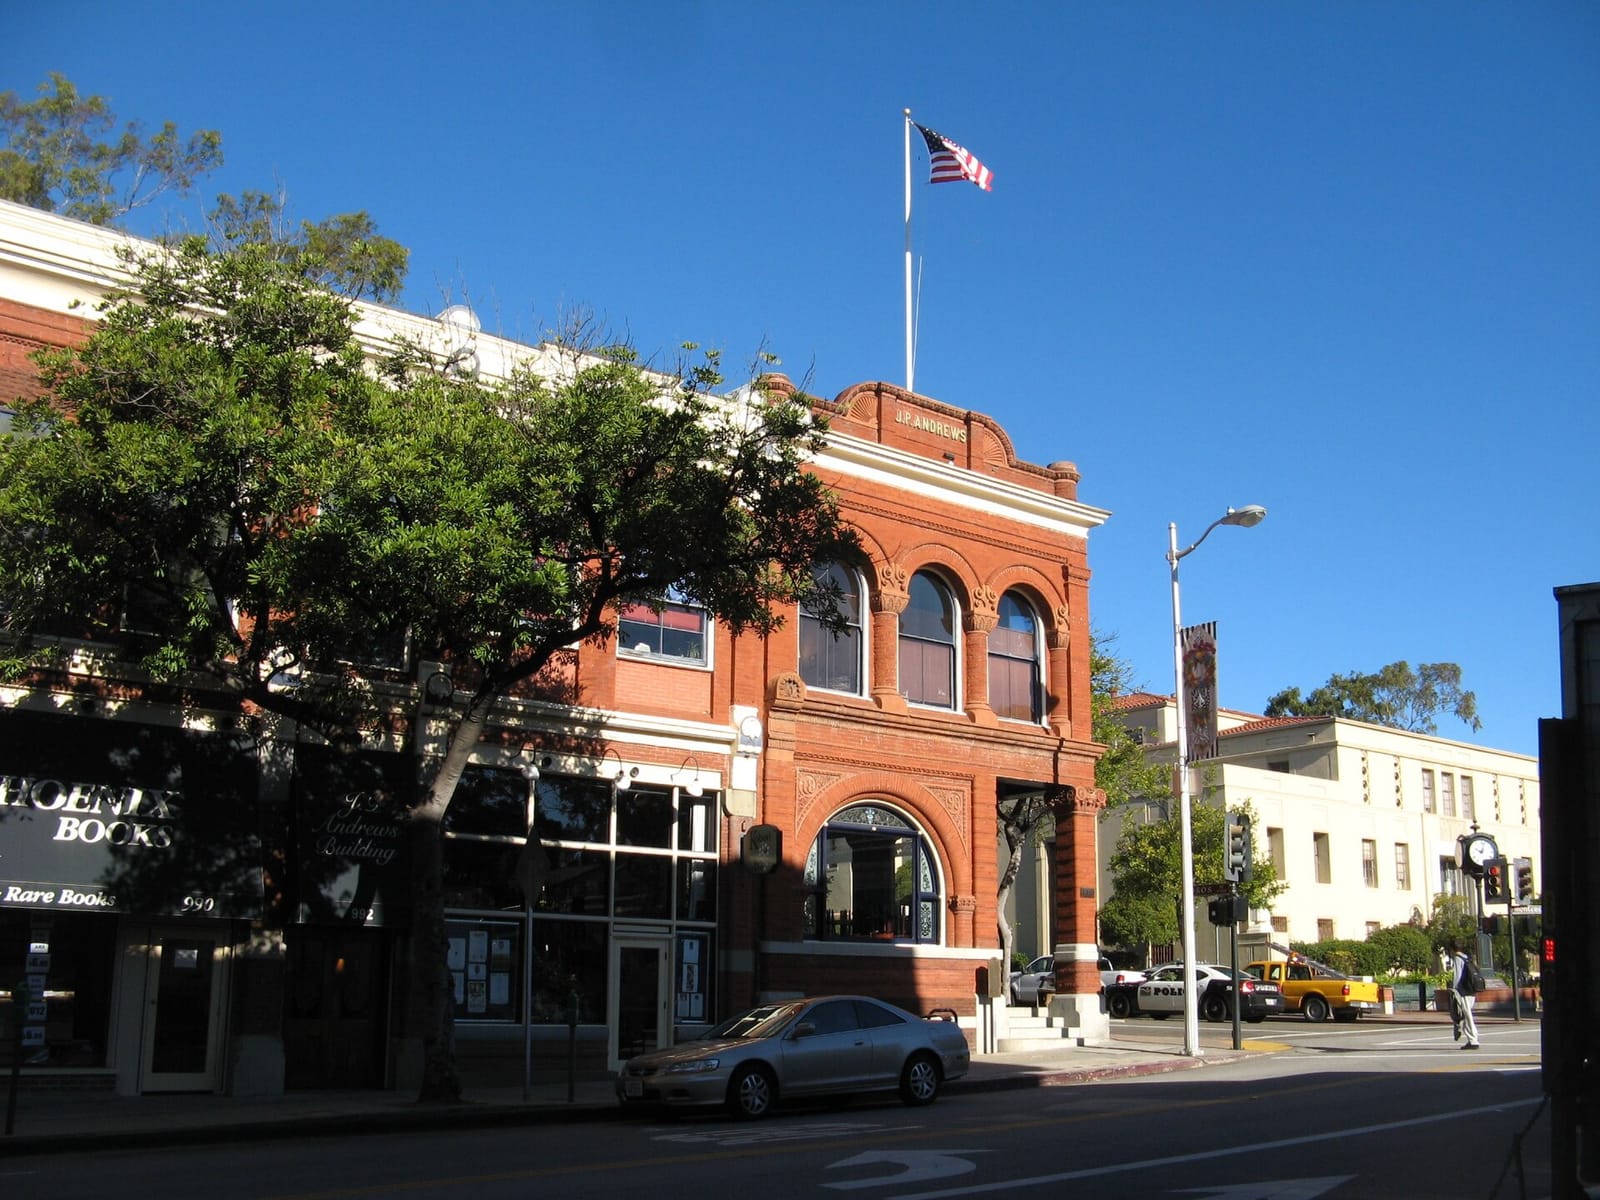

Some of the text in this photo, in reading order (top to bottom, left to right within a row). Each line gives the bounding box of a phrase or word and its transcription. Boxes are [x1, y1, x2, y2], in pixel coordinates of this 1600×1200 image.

[913, 415, 967, 444] ANDREWS
[53, 816, 173, 849] BOOKS
[312, 813, 400, 838] Andrews
[315, 836, 399, 866] Building
[4, 885, 117, 907] Rare Books
[181, 895, 215, 912] 990
[351, 907, 375, 921] 992
[1153, 987, 1185, 996] POLI
